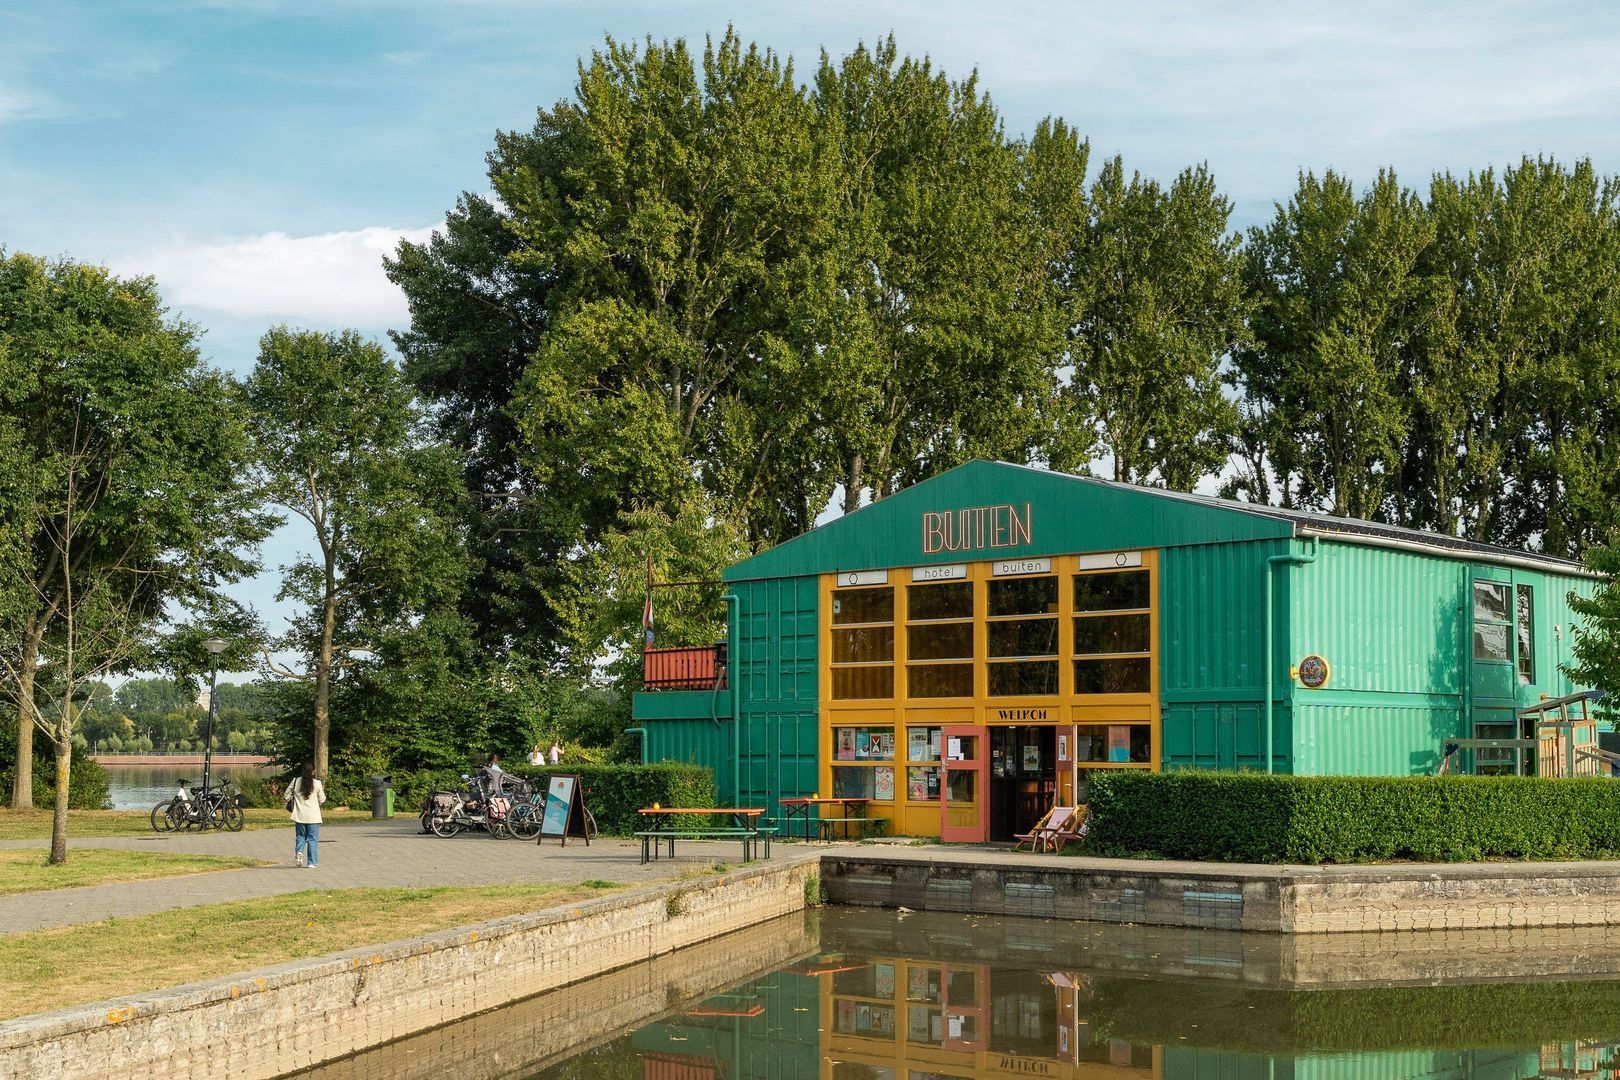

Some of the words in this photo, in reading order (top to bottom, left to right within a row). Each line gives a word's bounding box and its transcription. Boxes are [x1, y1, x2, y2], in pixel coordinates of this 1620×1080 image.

[923, 503, 1031, 553] BUITEN
[924, 567, 954, 579] hotel
[1002, 561, 1042, 573] buiten
[998, 709, 1047, 721] WELKOM
